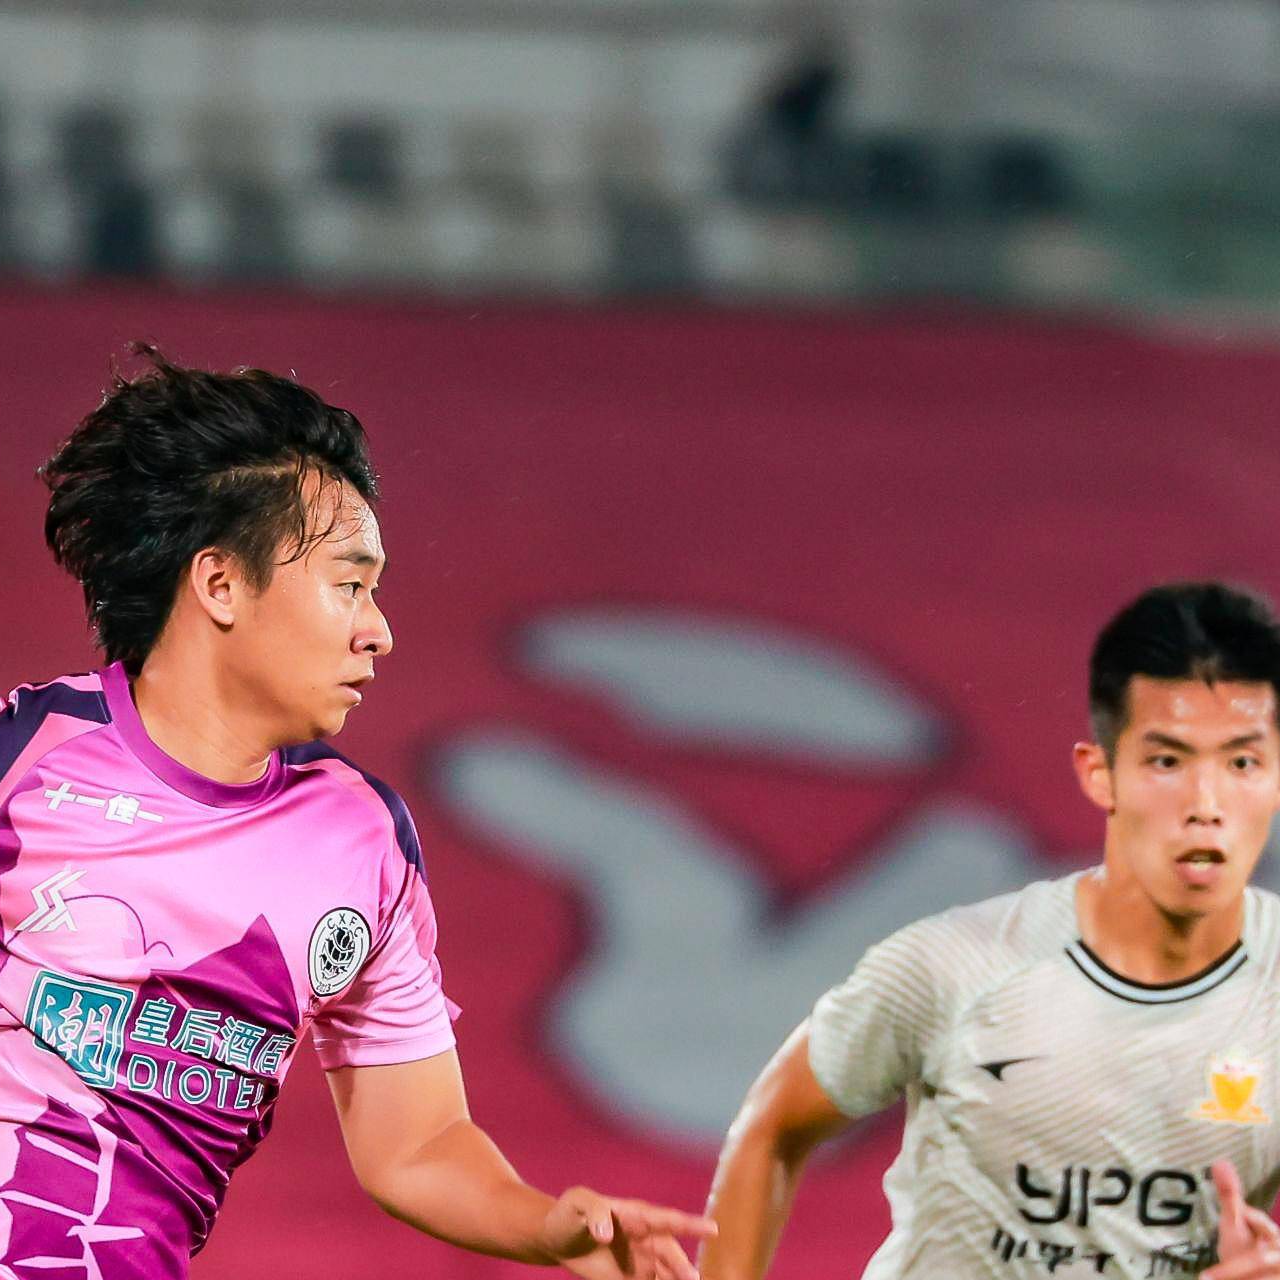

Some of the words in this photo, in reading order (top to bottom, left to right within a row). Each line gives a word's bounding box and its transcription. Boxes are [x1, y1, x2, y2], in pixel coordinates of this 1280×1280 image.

[130, 998, 297, 1075] 皇后酒店
[1015, 1162, 1213, 1227] YPG
